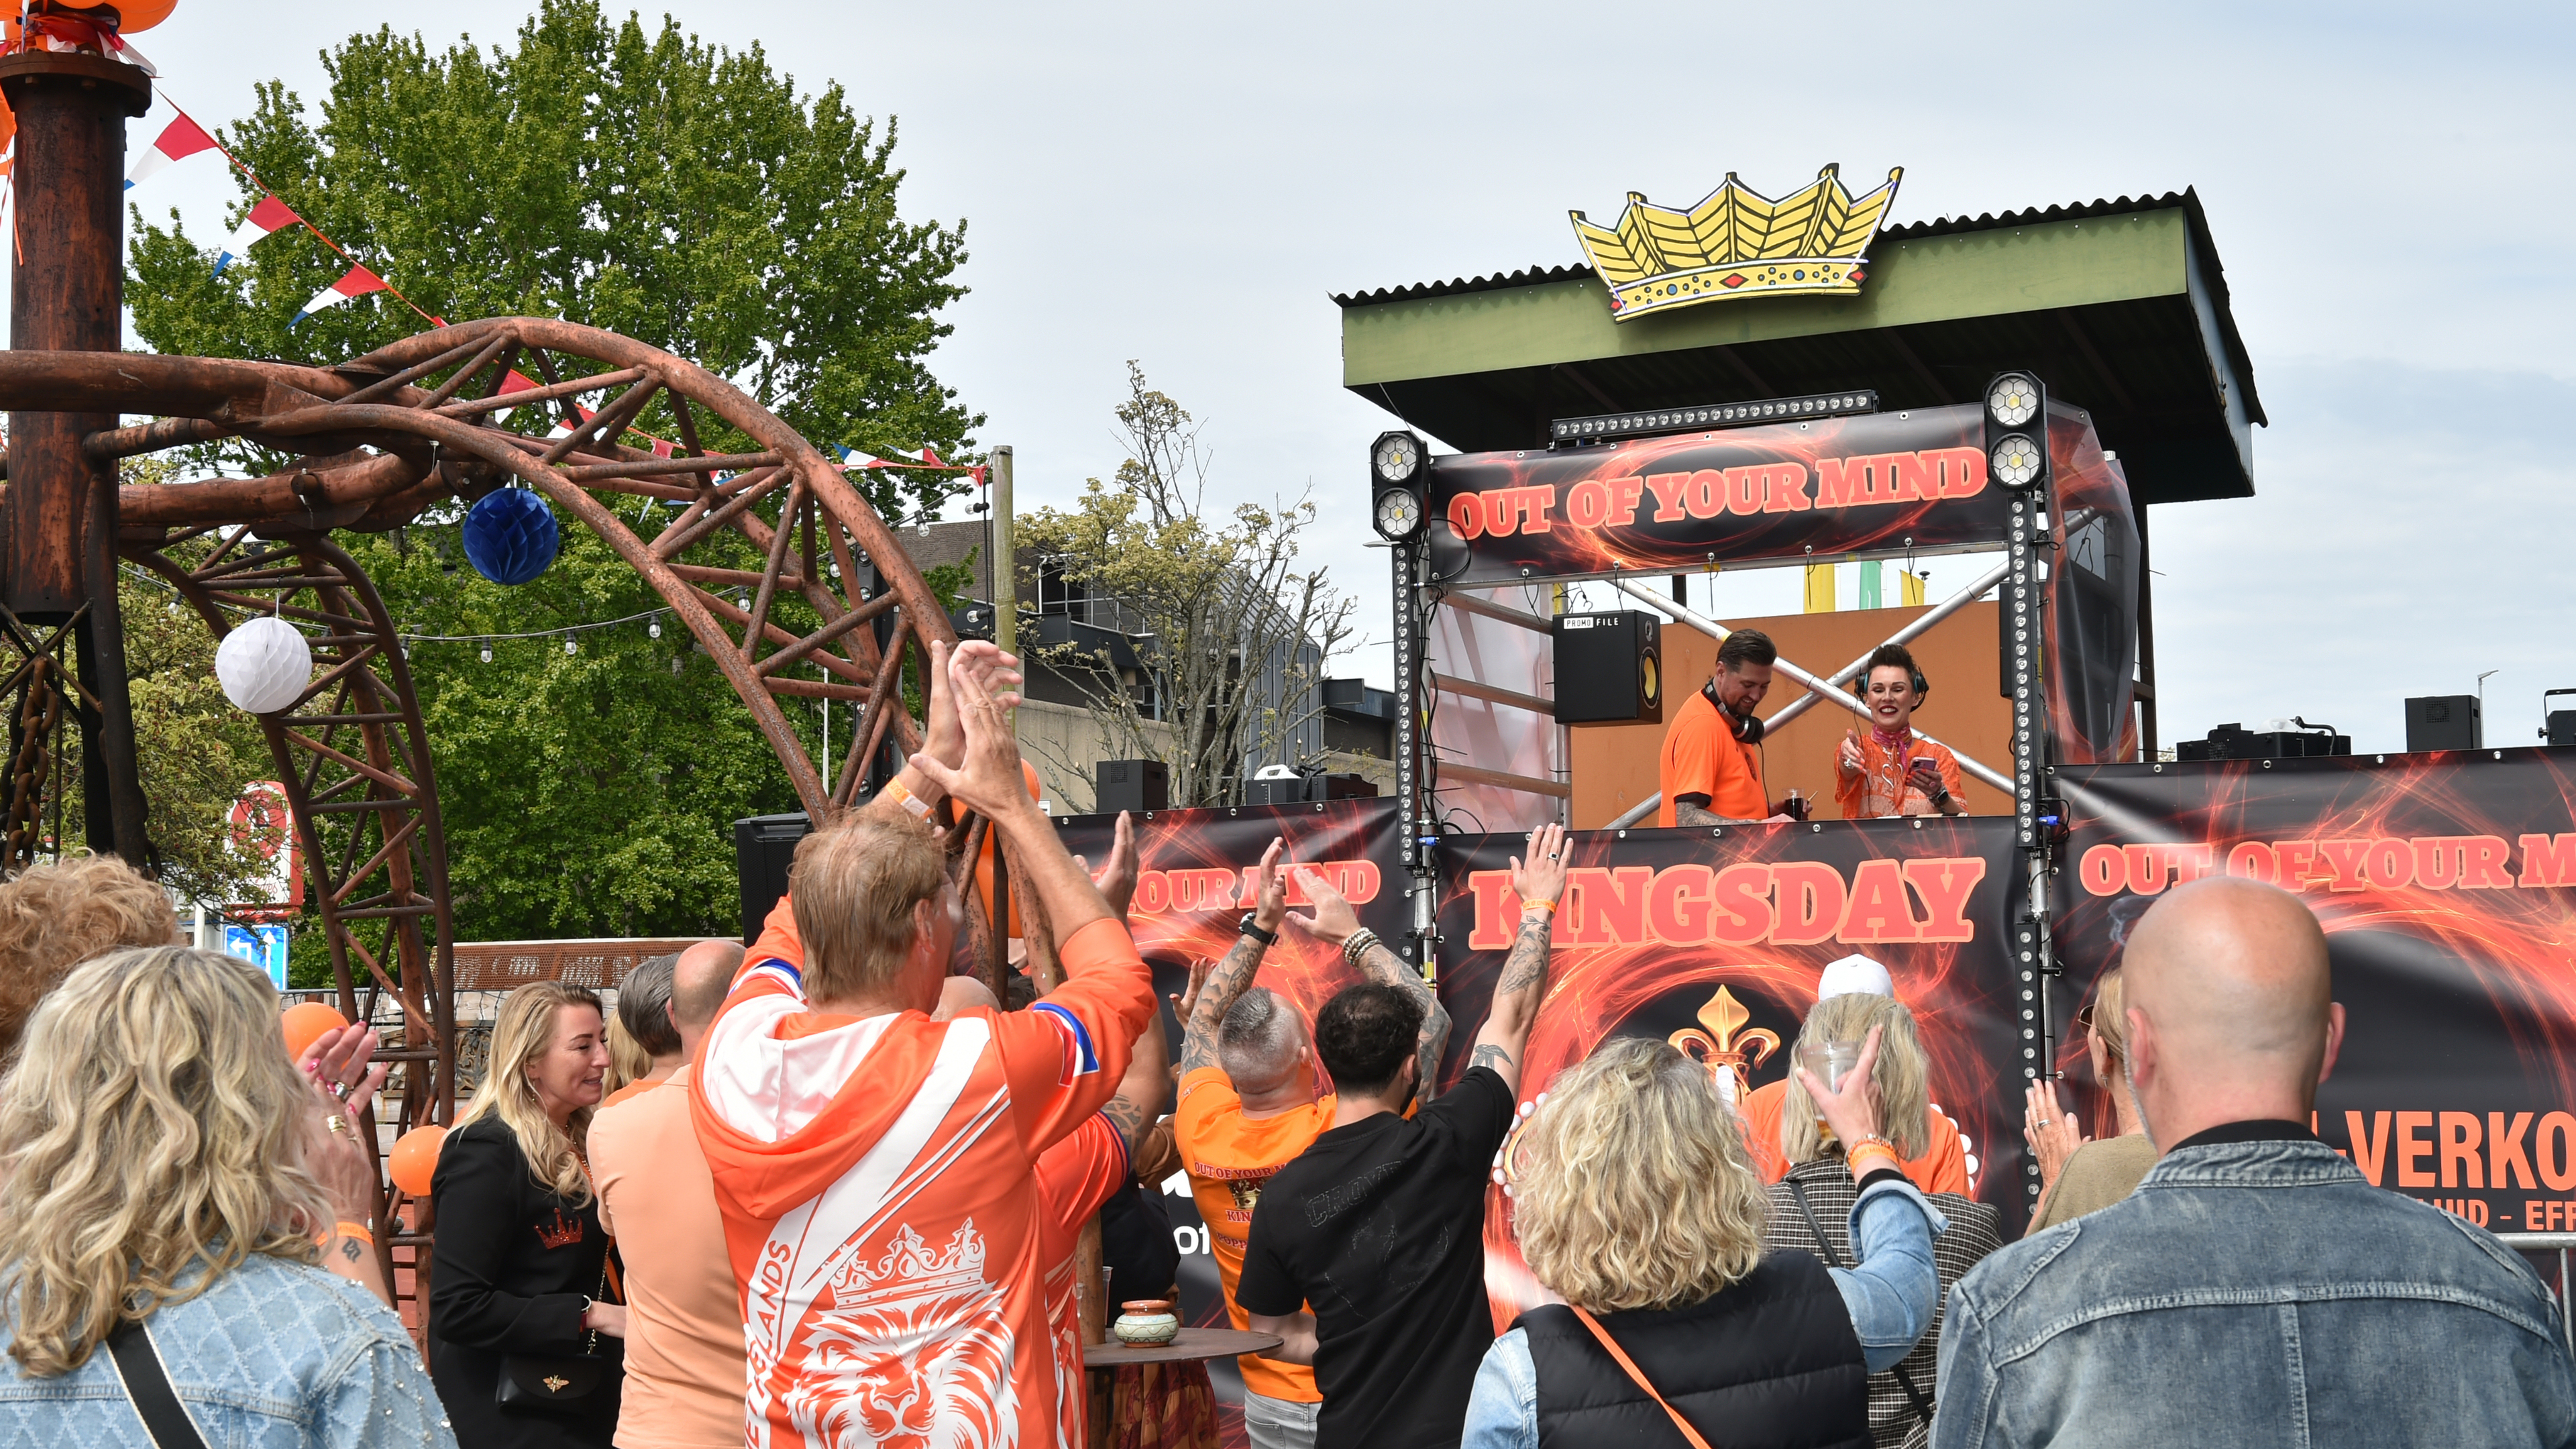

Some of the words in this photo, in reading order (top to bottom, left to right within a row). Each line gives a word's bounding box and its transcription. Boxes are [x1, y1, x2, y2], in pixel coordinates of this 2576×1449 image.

[1448, 484, 1556, 541] OUT
[1567, 476, 1643, 529] OF
[1644, 462, 1813, 523] YOUR
[1813, 446, 1988, 508] MIND
[1566, 619, 1591, 628] PROMO
[1596, 617, 1619, 627] FILE
[2080, 843, 2212, 896] OUT
[2226, 840, 2316, 893] OF
[2318, 836, 2514, 892] YOUR
[1090, 867, 1236, 915] OUR
[1194, 1161, 1214, 1178] OUT
[1232, 1167, 1275, 1179] YOUR
[1225, 1210, 1253, 1222] KIN
